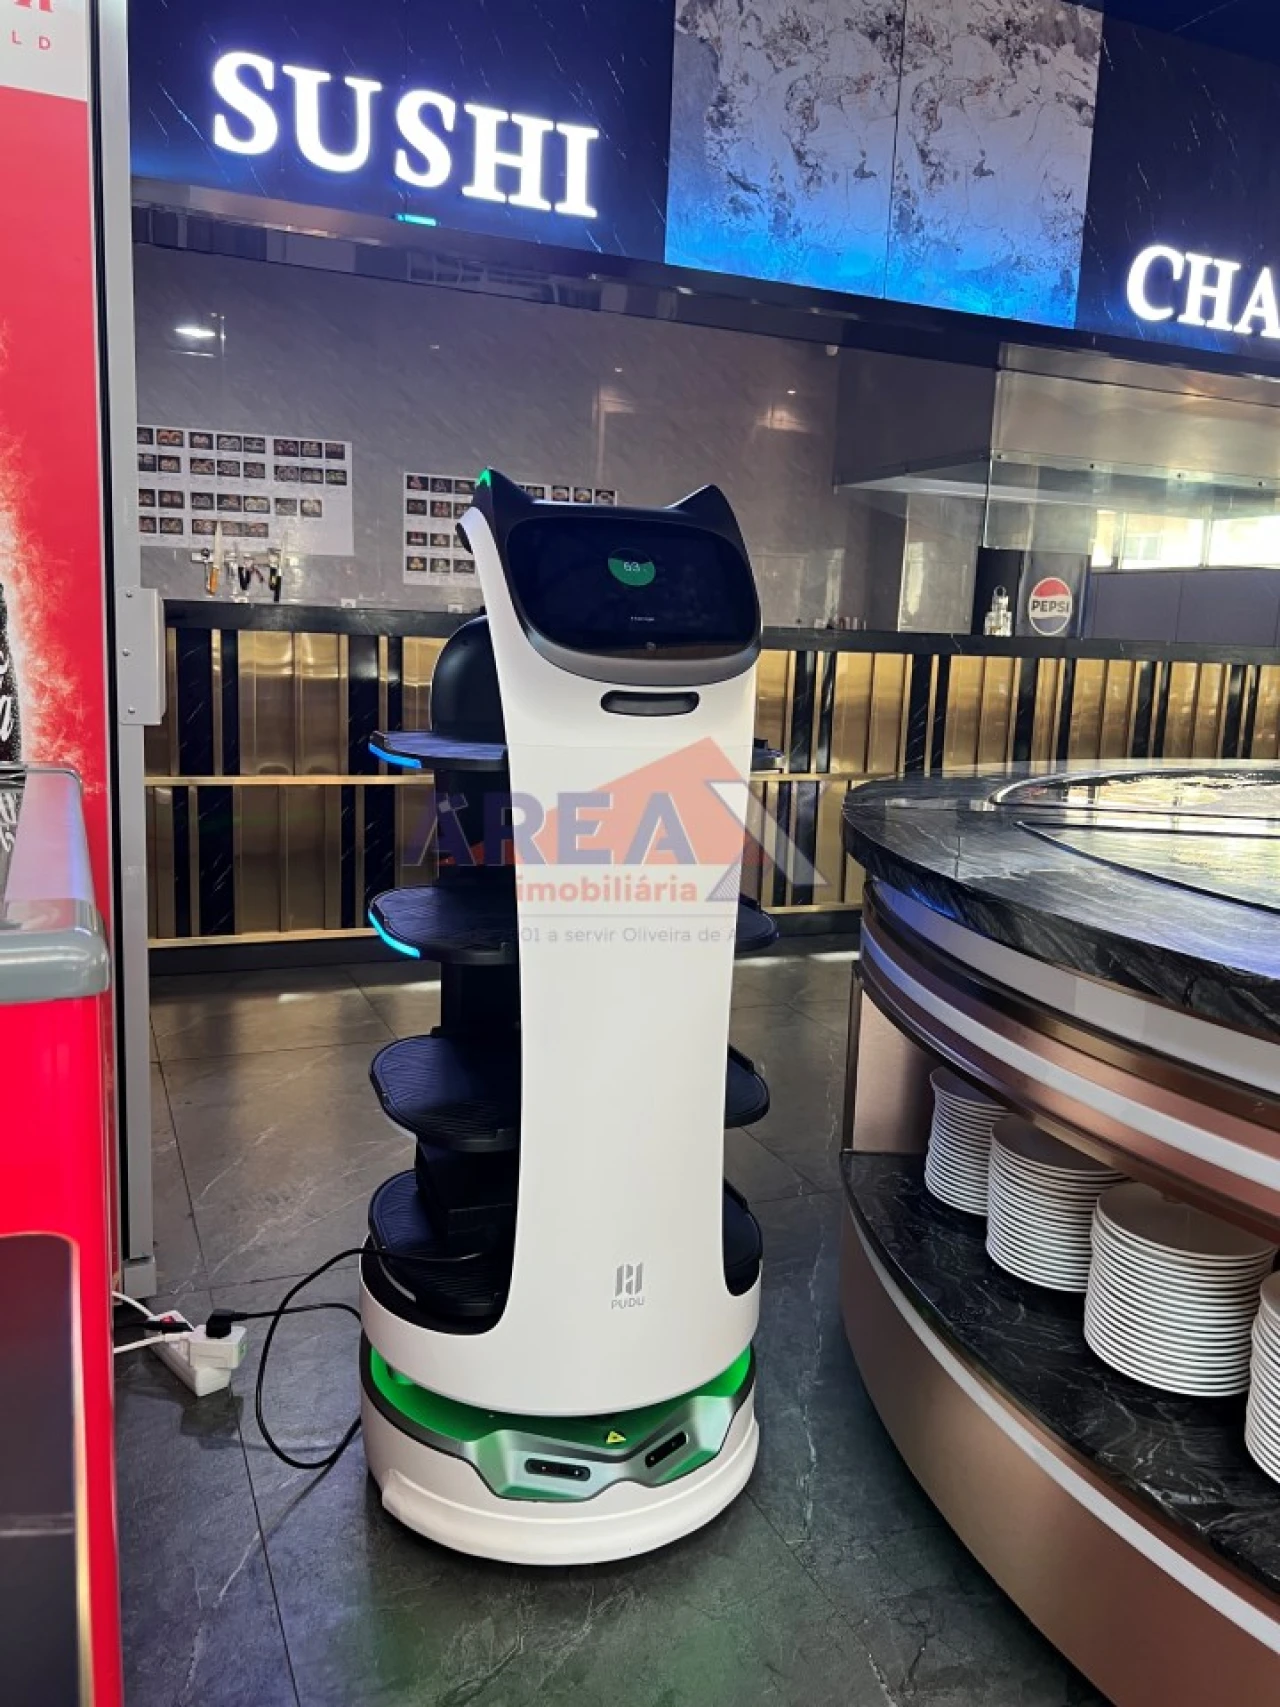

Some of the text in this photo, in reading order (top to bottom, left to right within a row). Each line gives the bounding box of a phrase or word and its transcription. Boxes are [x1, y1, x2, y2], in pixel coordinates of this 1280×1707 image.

[212, 51, 600, 218] SUSHI
[1127, 245, 1280, 339] CHA
[1032, 600, 1070, 613] PEPSI
[611, 1297, 645, 1310] PUDU
